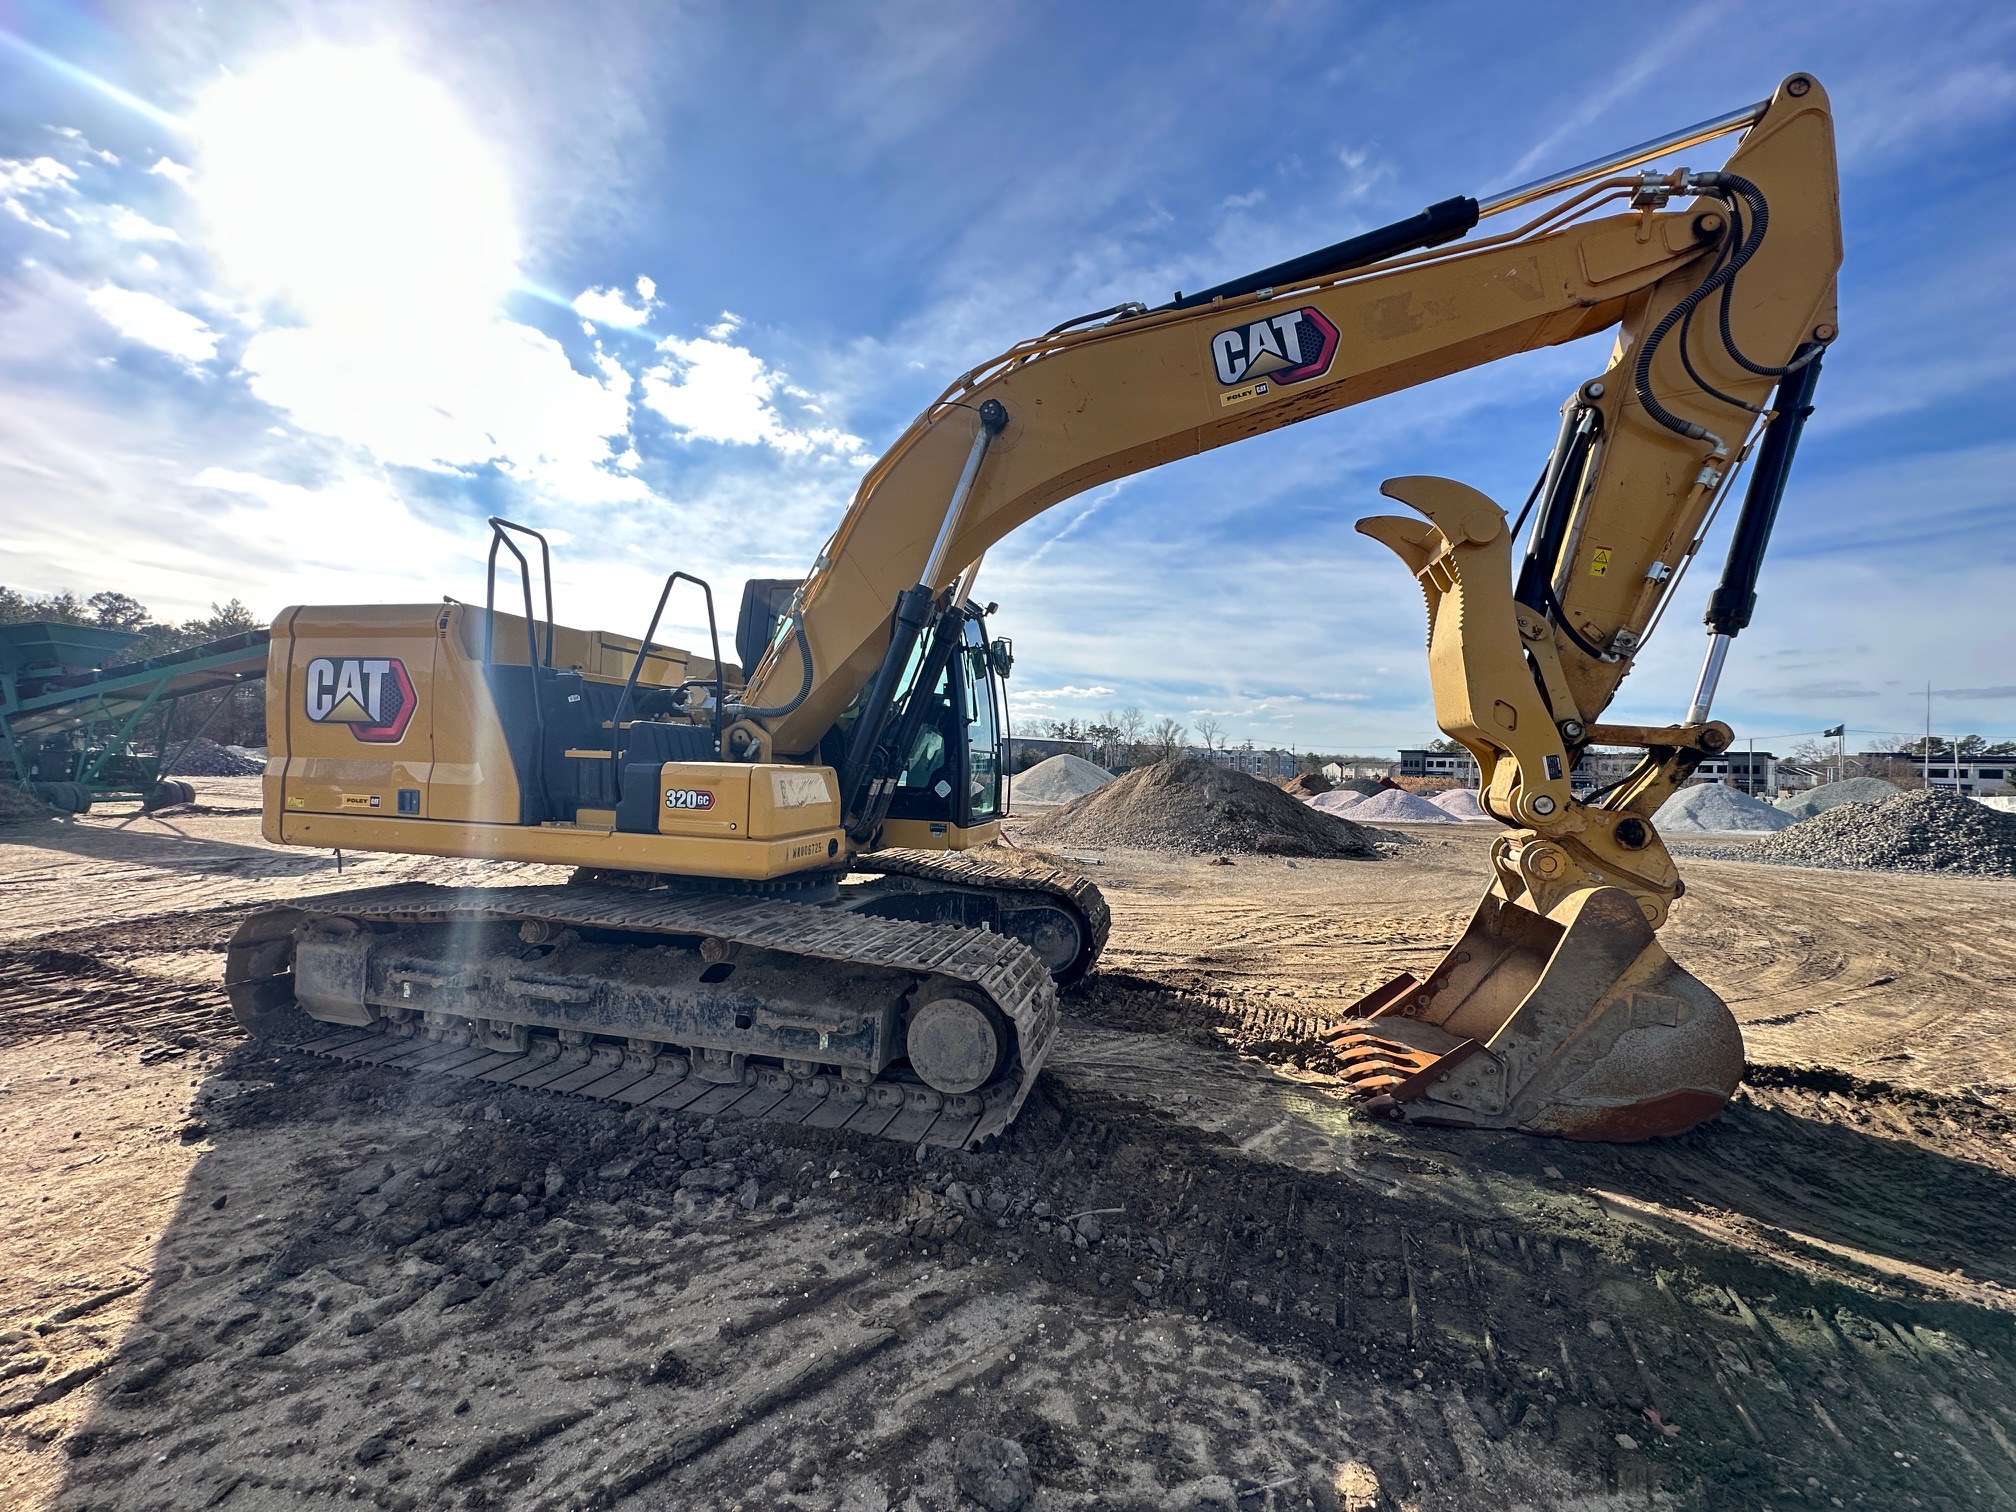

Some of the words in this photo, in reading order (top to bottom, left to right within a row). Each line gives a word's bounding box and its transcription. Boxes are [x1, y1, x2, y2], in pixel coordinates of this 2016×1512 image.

[1212, 310, 1303, 384] CAT
[1226, 390, 1252, 401] FOLEY
[1256, 385, 1267, 393] CAT
[307, 658, 390, 722] CAT
[665, 789, 697, 808] 320
[697, 795, 710, 806] GC
